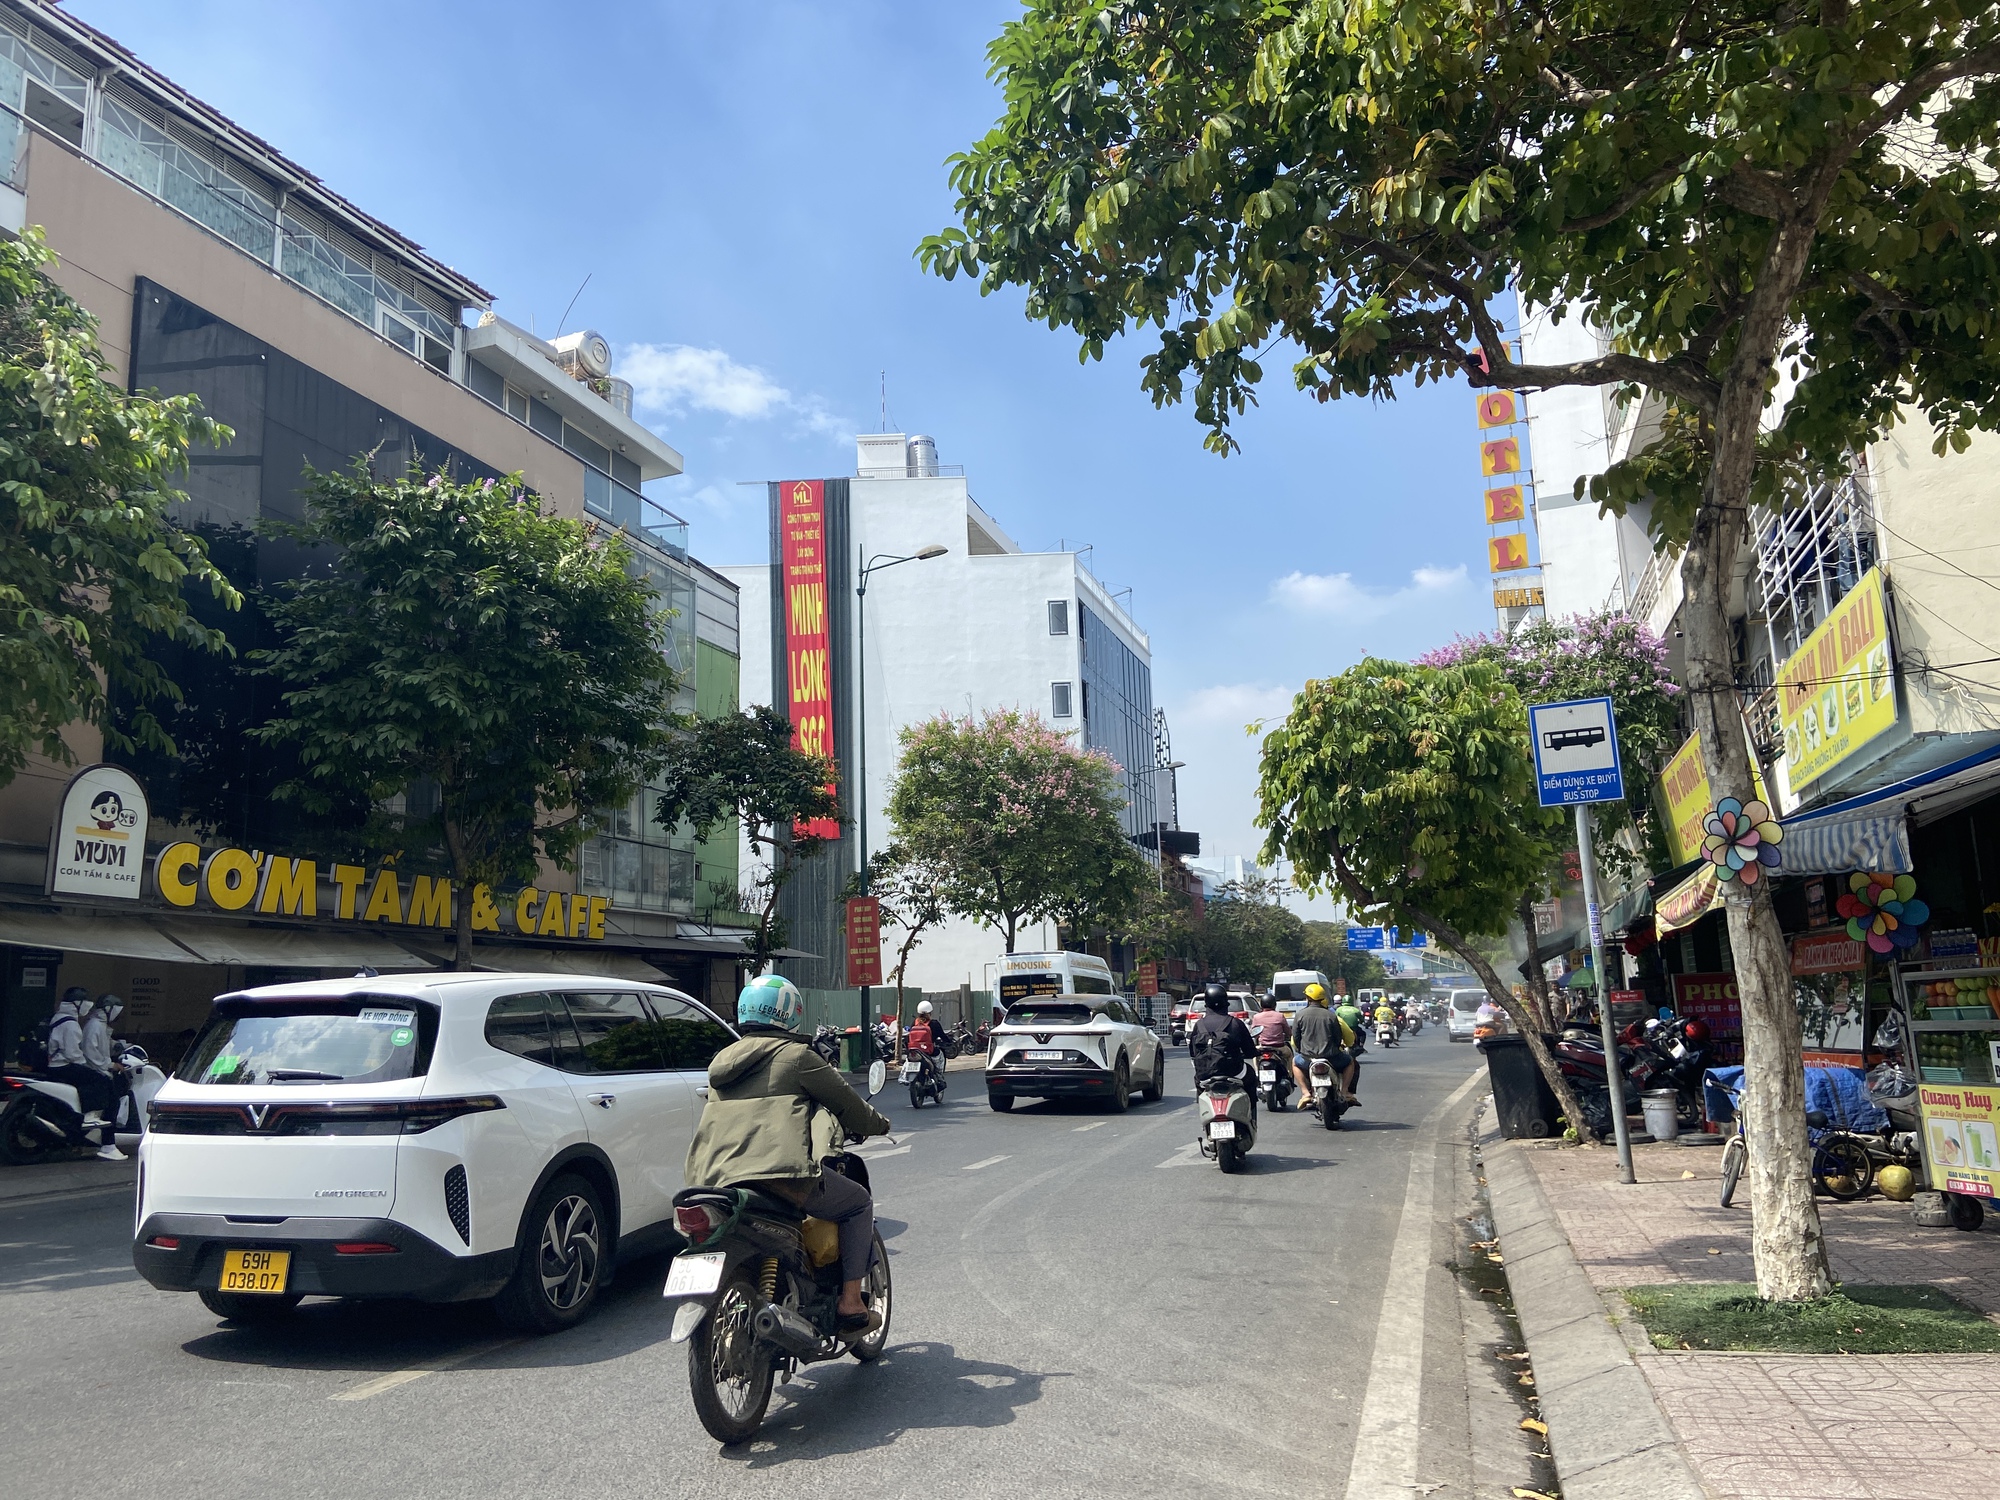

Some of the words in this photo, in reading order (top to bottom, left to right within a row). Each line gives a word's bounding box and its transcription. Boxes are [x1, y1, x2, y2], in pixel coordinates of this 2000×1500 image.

[1472, 344, 1522, 570] OTEL
[1784, 648, 1818, 717] BÁNH
[1818, 622, 1838, 684] MÌ
[1839, 588, 1875, 667] BALI
[1543, 776, 1562, 790] ĐIỂM
[1563, 775, 1585, 787] DỪNG
[1586, 775, 1597, 785] XE
[1597, 771, 1617, 784] BUÝT
[1563, 791, 1579, 801] BUS
[1580, 789, 1599, 799] STOP
[60, 867, 81, 876] CƠM
[84, 869, 103, 879] TẤM
[105, 872, 111, 880] &
[114, 873, 136, 882] CAFE
[154, 841, 317, 917] CƠM
[330, 850, 452, 929] TẤM
[471, 882, 501, 932] &
[1007, 960, 1052, 970] LIMOUSINE
[132, 977, 160, 985] GOOD
[361, 1012, 372, 1020] XE
[372, 1011, 387, 1022] HỢP
[388, 1010, 409, 1022] ĐỒNG
[758, 1003, 790, 1020] LEOPARD
[1707, 1004, 1722, 1012] CHI
[1921, 1088, 1961, 1110] Quang
[1963, 1091, 1992, 1112] Huy
[345, 1189, 387, 1198] GREEN
[241, 1253, 270, 1270] 69H
[227, 1271, 280, 1291] 038.07
